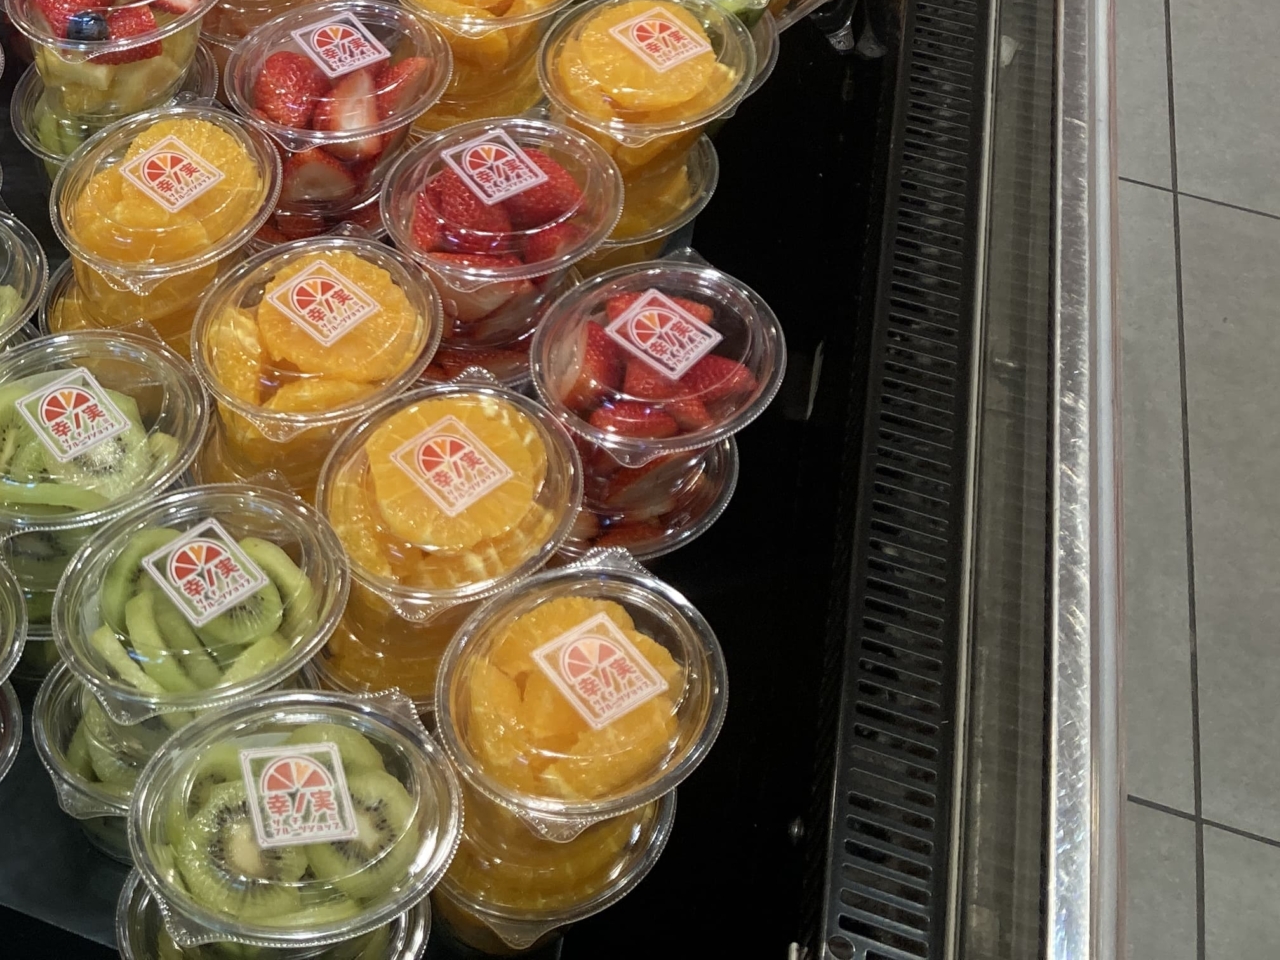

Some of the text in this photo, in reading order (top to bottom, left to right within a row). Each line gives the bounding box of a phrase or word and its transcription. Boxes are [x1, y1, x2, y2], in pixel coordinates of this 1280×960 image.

[428, 448, 486, 491] 幸ノ実
[179, 554, 241, 601] 幸ノ実
[573, 654, 638, 700] 幸ノ実
[264, 788, 336, 818] 幸ノ実
